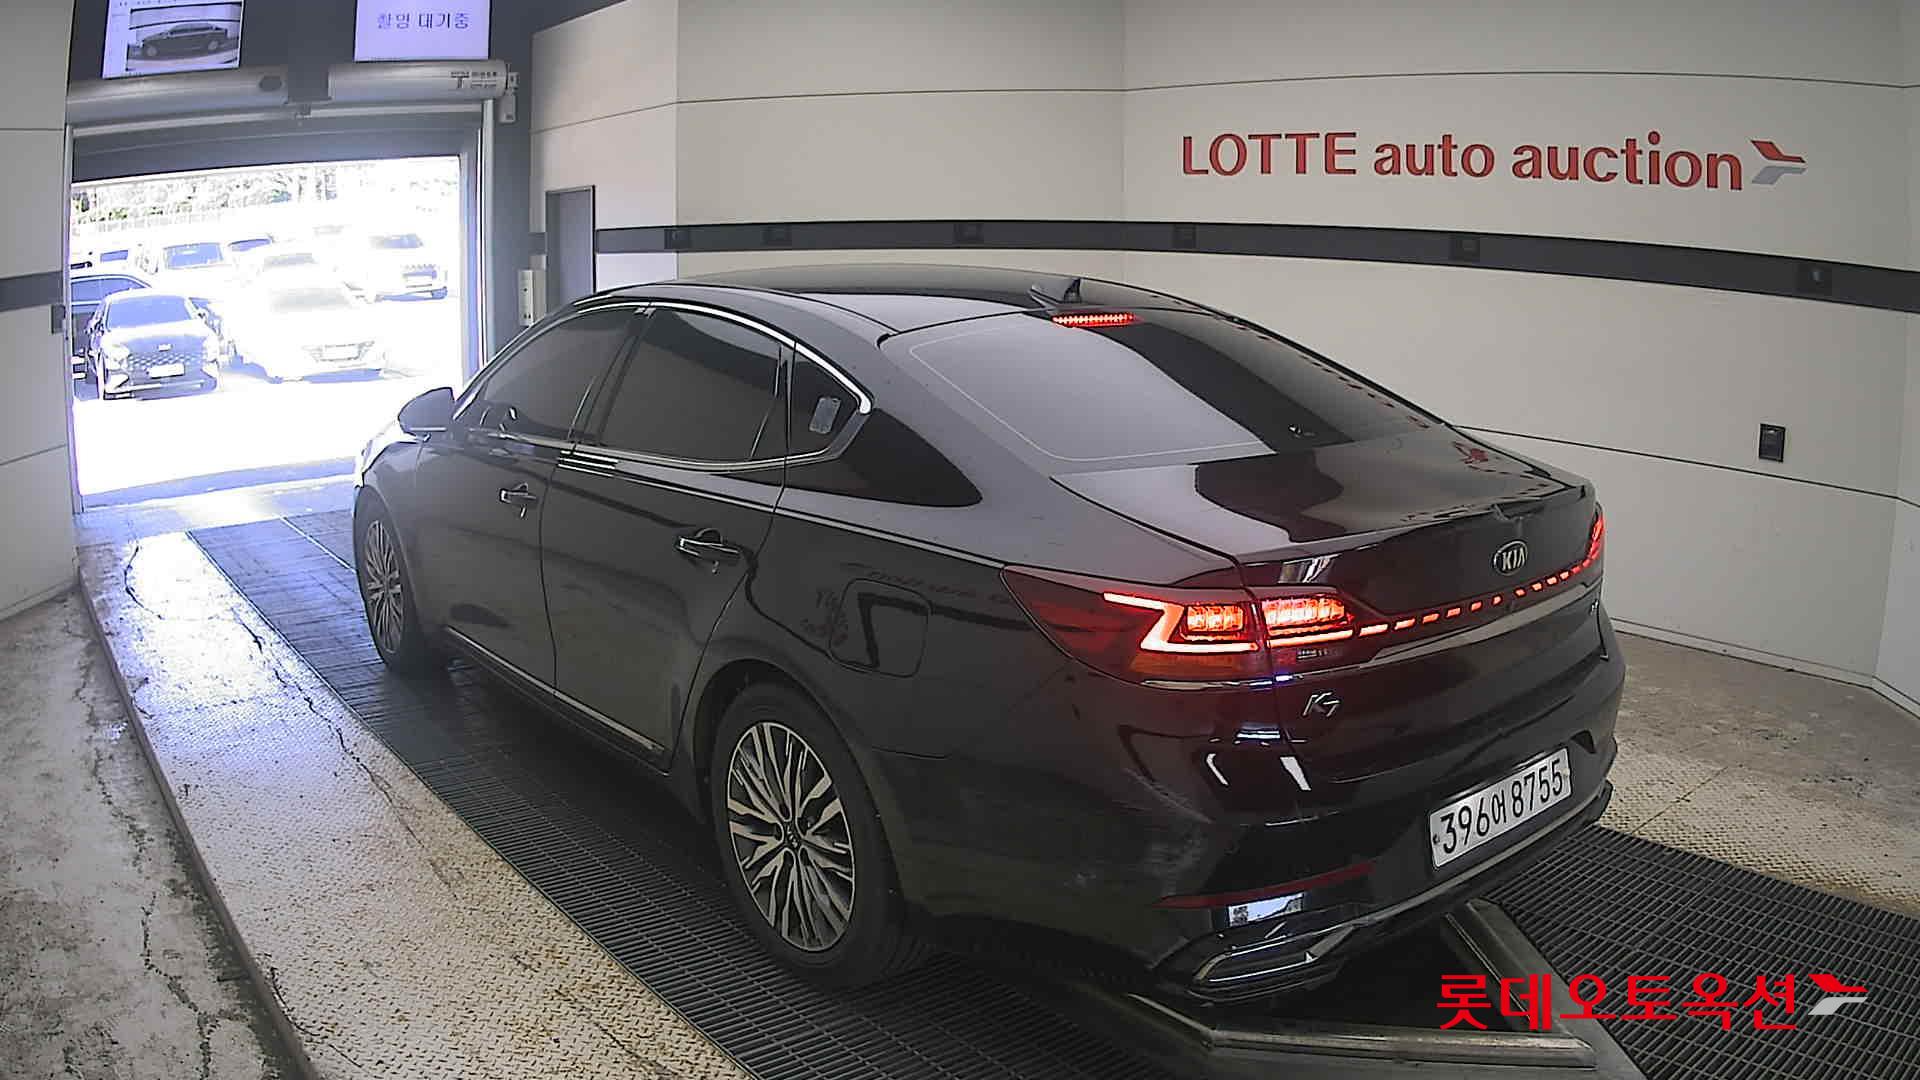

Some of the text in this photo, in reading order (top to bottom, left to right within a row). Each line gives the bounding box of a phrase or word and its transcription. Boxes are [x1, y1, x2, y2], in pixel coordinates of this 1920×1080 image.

[1182, 131, 1743, 191] LOTTE auto auction
[1501, 546, 1527, 573] KIA
[1302, 691, 1341, 718] K7
